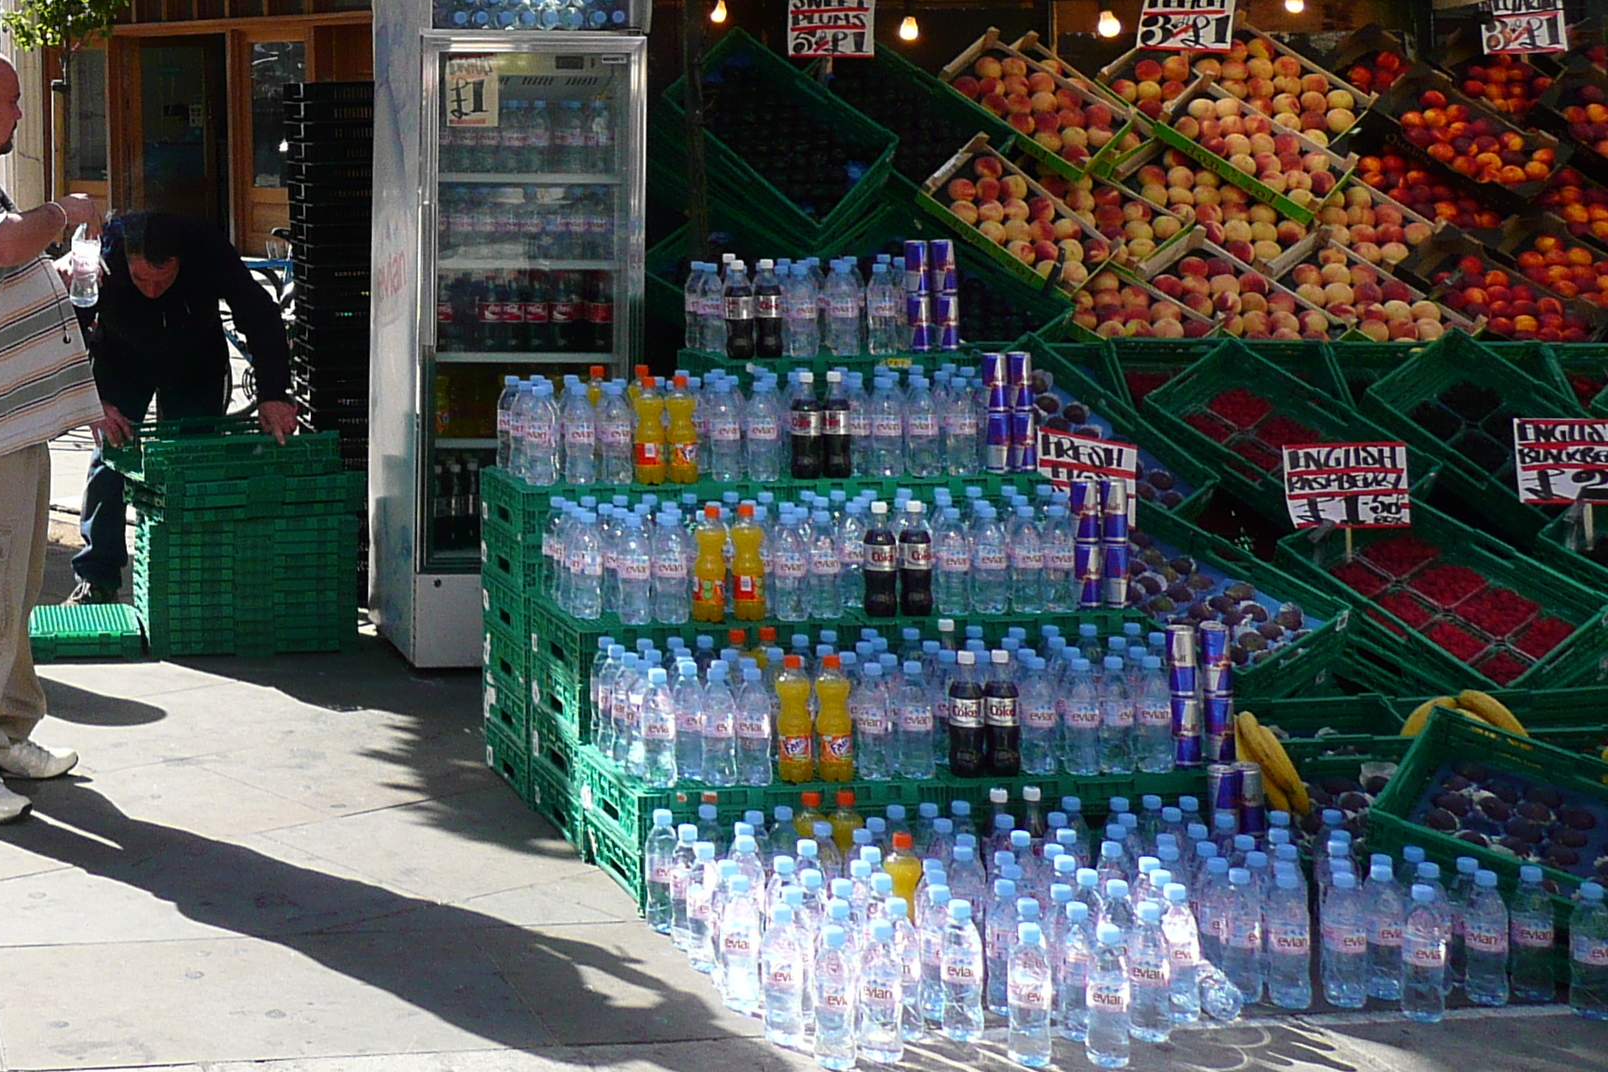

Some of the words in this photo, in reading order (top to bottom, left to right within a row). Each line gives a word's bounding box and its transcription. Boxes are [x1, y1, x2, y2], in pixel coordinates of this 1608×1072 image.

[792, 13, 867, 28] PLUMS
[450, 77, 490, 120] £1
[375, 249, 408, 305] evian
[1288, 445, 1397, 470] ENGLISH
[780, 561, 805, 572] evian
[813, 558, 840, 568] evian
[952, 705, 978, 719] Coke
[991, 704, 1016, 718] Coke
[1029, 710, 1055, 722] evian
[1072, 710, 1098, 723] evian
[1141, 708, 1170, 721] evian
[903, 714, 930, 725] evian
[1277, 934, 1309, 949] evian
[1466, 930, 1498, 946] evian
[1520, 928, 1553, 942] evian
[725, 937, 750, 950] evia
[947, 963, 975, 978] evia
[863, 984, 894, 1000] evian
